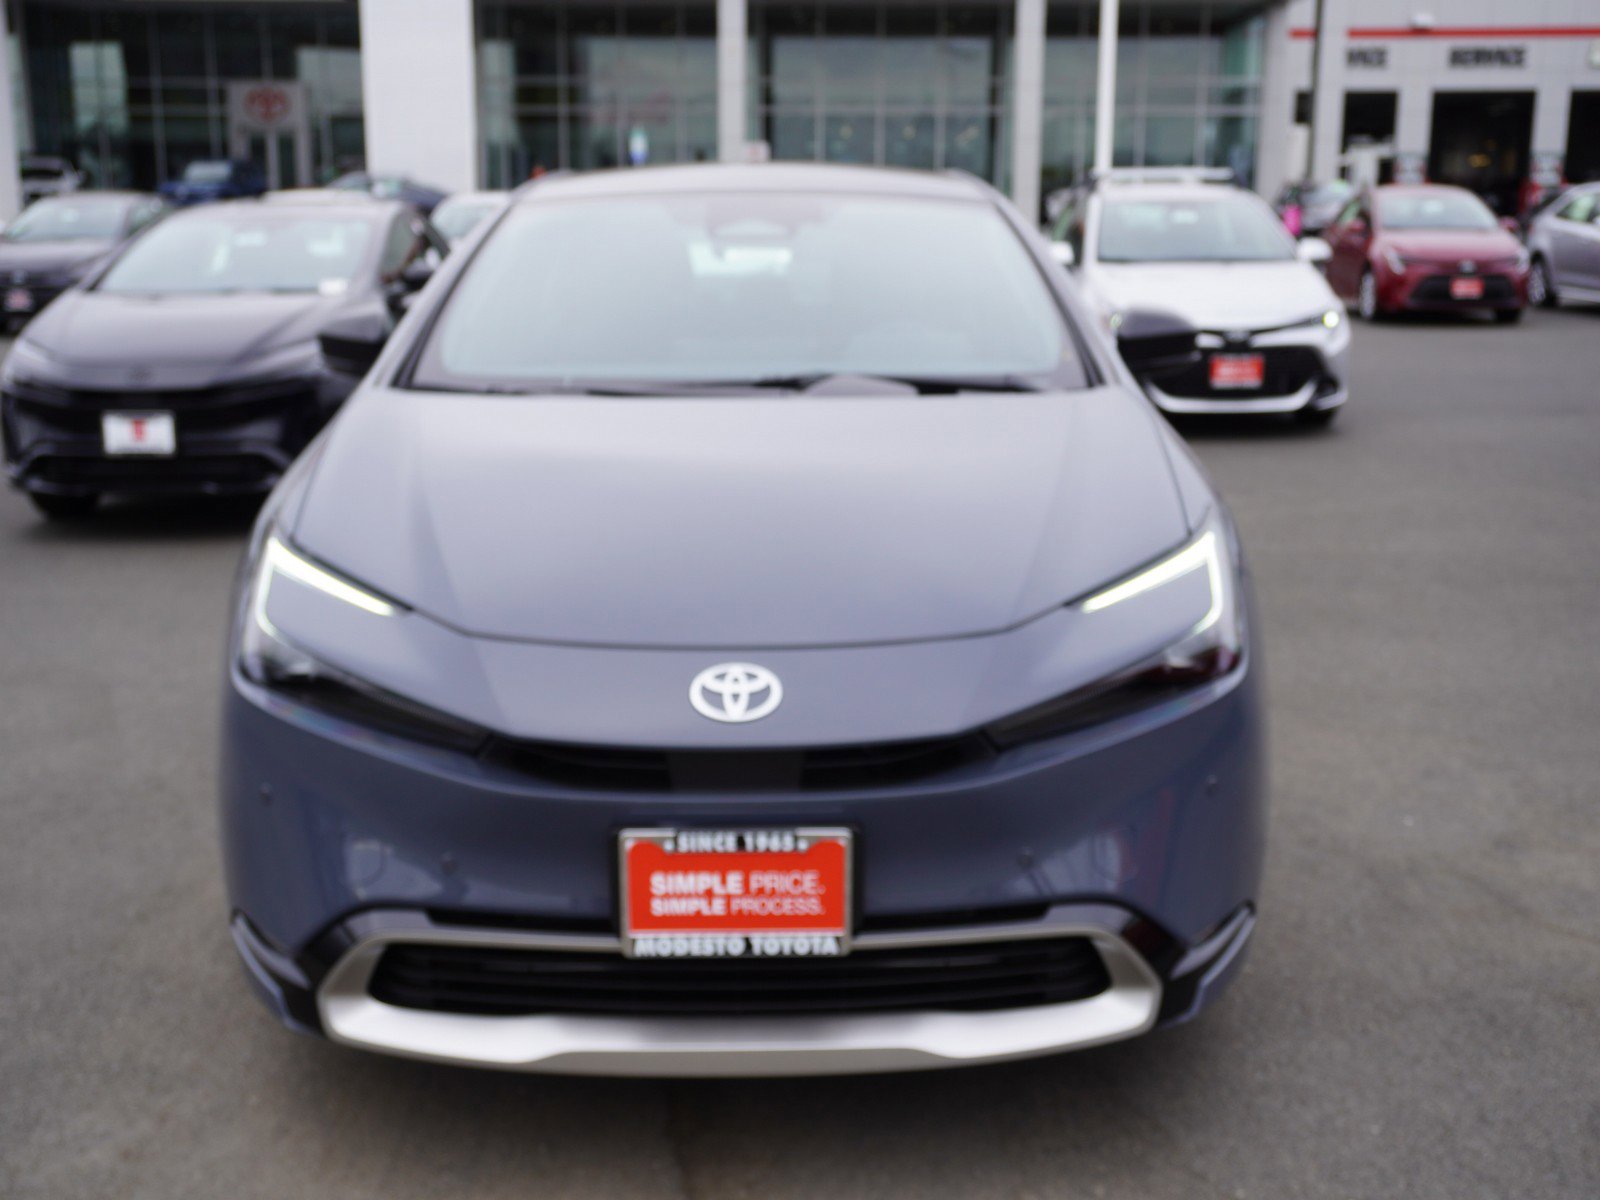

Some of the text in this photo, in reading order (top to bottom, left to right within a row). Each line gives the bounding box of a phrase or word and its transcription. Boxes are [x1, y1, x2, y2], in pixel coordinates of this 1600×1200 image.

[1449, 47, 1525, 67] SERVICE
[677, 831, 737, 853] SINCE
[650, 871, 826, 895] SIMPLE PRICE.
[650, 897, 727, 916] SIMPLE
[634, 936, 839, 957] MODESTO TOYOTA
